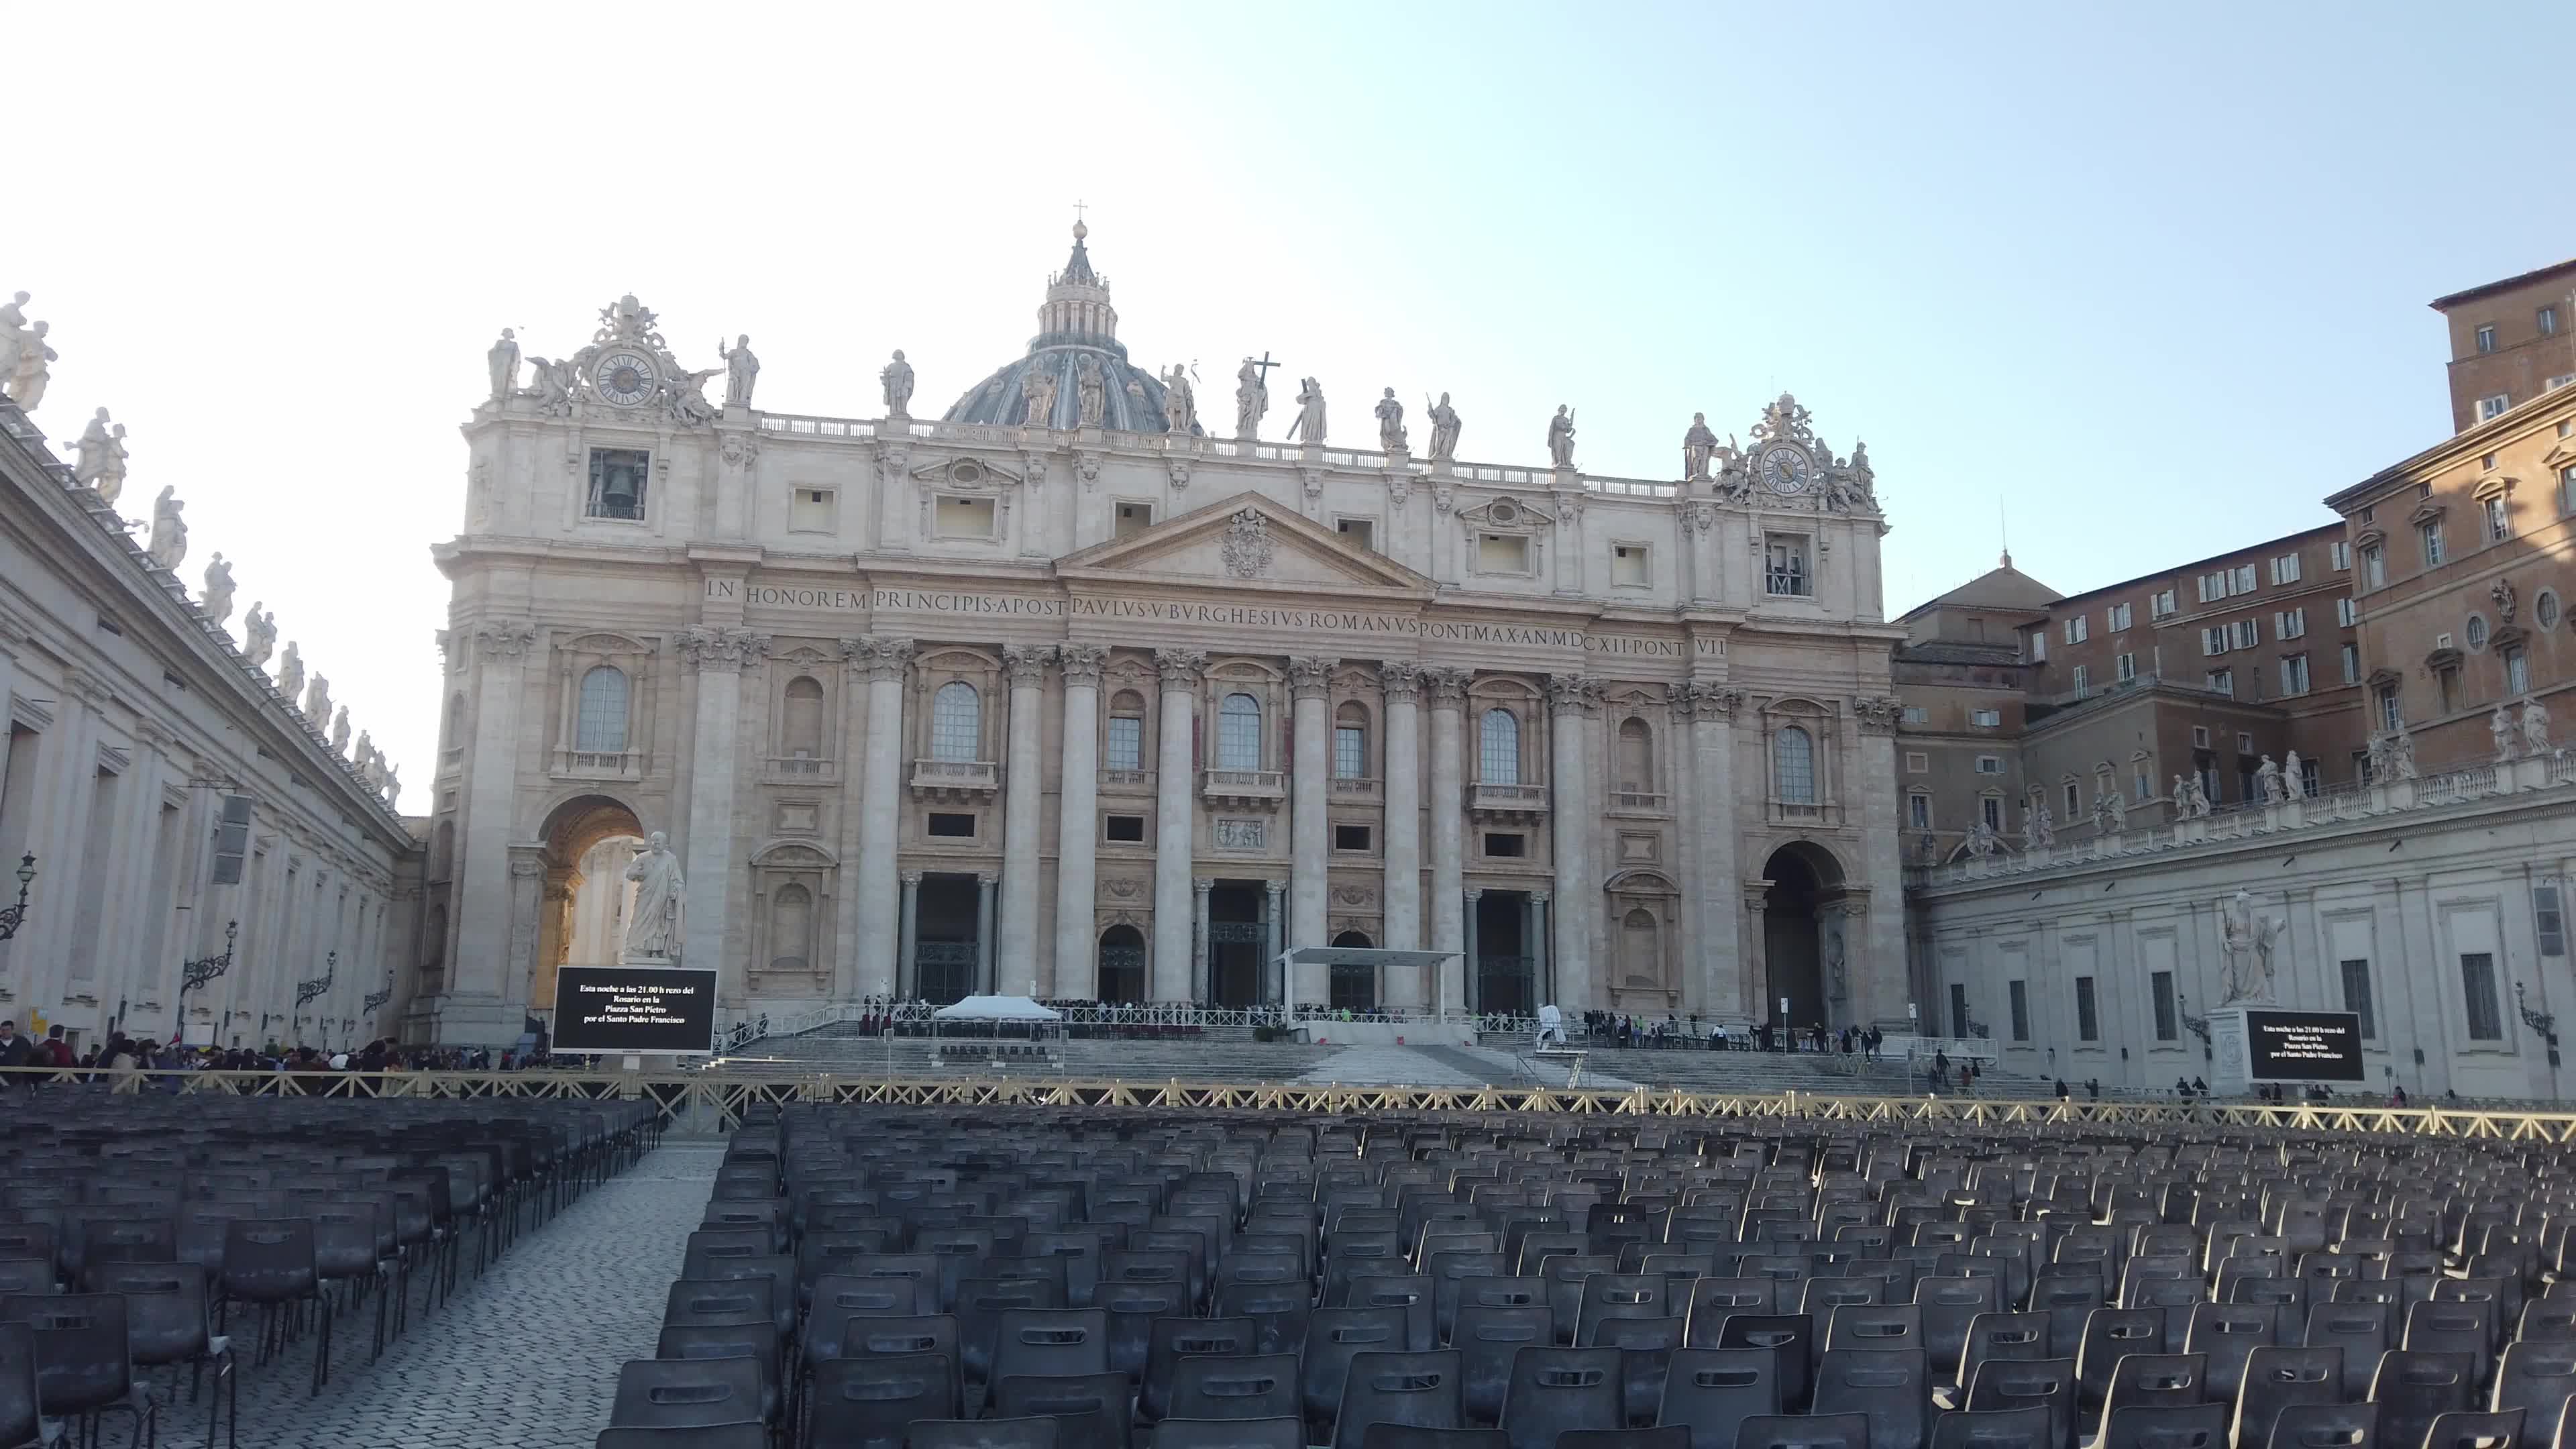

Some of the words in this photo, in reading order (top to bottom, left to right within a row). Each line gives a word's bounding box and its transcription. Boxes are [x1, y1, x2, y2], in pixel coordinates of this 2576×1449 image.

[707, 581, 735, 597] IN
[746, 588, 867, 609] HONOREM
[1073, 598, 1146, 617] PAVLVS
[1169, 604, 1303, 627] BVRGHESIVS
[1310, 612, 1417, 633] ROMANVS
[1419, 622, 1473, 640] PONT
[1633, 639, 1686, 656] PONT
[1697, 639, 1724, 655] VII
[580, 984, 596, 992] Esta
[597, 985, 619, 993] noche
[613, 995, 641, 1003] Rosario
[653, 996, 659, 1004] la
[645, 1006, 666, 1014] Pietro
[584, 1016, 597, 1024] por
[598, 1014, 605, 1022] el
[606, 1014, 627, 1022] Santo
[629, 1015, 649, 1023] Padre
[651, 1016, 685, 1024] Francisco
